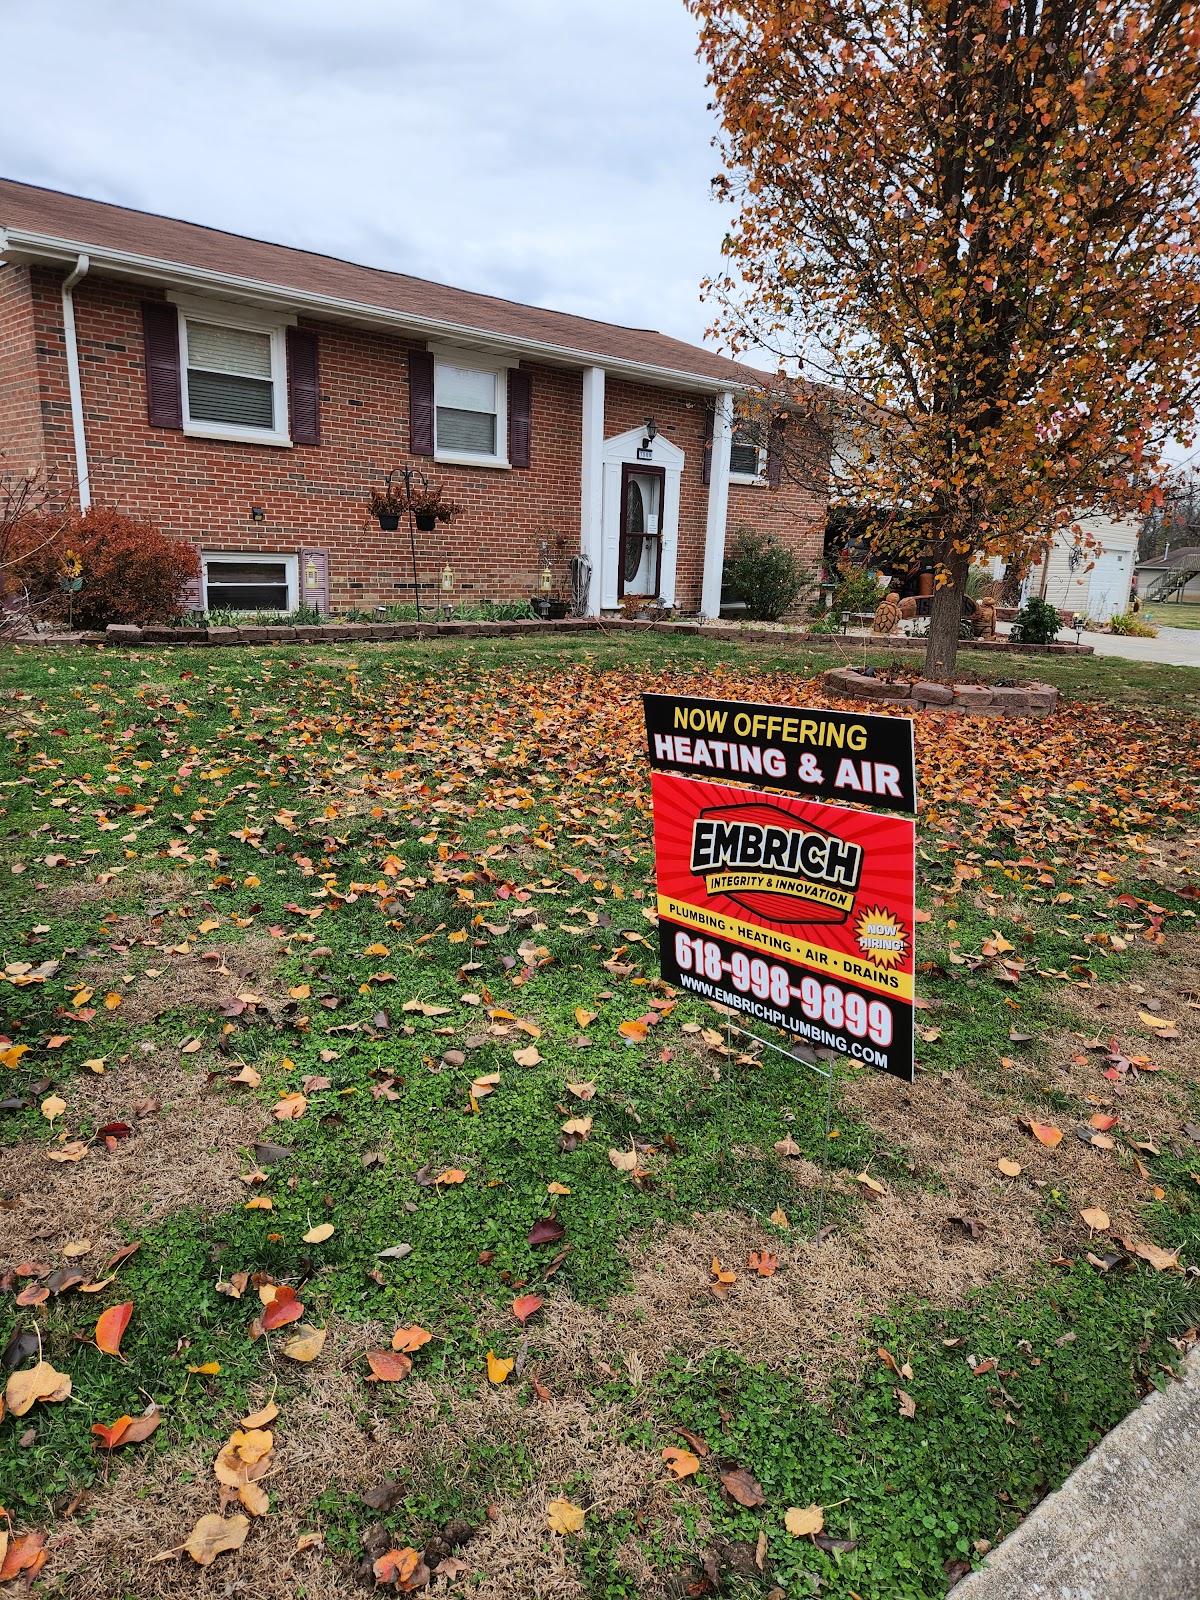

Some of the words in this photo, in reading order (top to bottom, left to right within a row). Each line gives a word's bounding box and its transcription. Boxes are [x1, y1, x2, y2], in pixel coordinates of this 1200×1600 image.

[673, 706, 728, 734] NOW
[733, 712, 868, 751] OFFERING
[653, 733, 787, 779] HEATING
[797, 752, 825, 785] &
[834, 757, 904, 798] AIR
[690, 818, 862, 888] EMBRICH
[710, 875, 765, 889] INTEGRITY
[766, 878, 773, 887] &
[775, 879, 848, 905] INNOVATION
[669, 903, 726, 931] PLUMBING
[737, 925, 792, 953] HEATING
[805, 948, 829, 965] AIR
[843, 960, 899, 989] DRAINS
[859, 936, 904, 951] HIRING!
[867, 924, 897, 936] NOW
[674, 930, 893, 1048] 618-998-9899
[679, 973, 888, 1069] WWW.EMBRICHPLUMBING.COM
